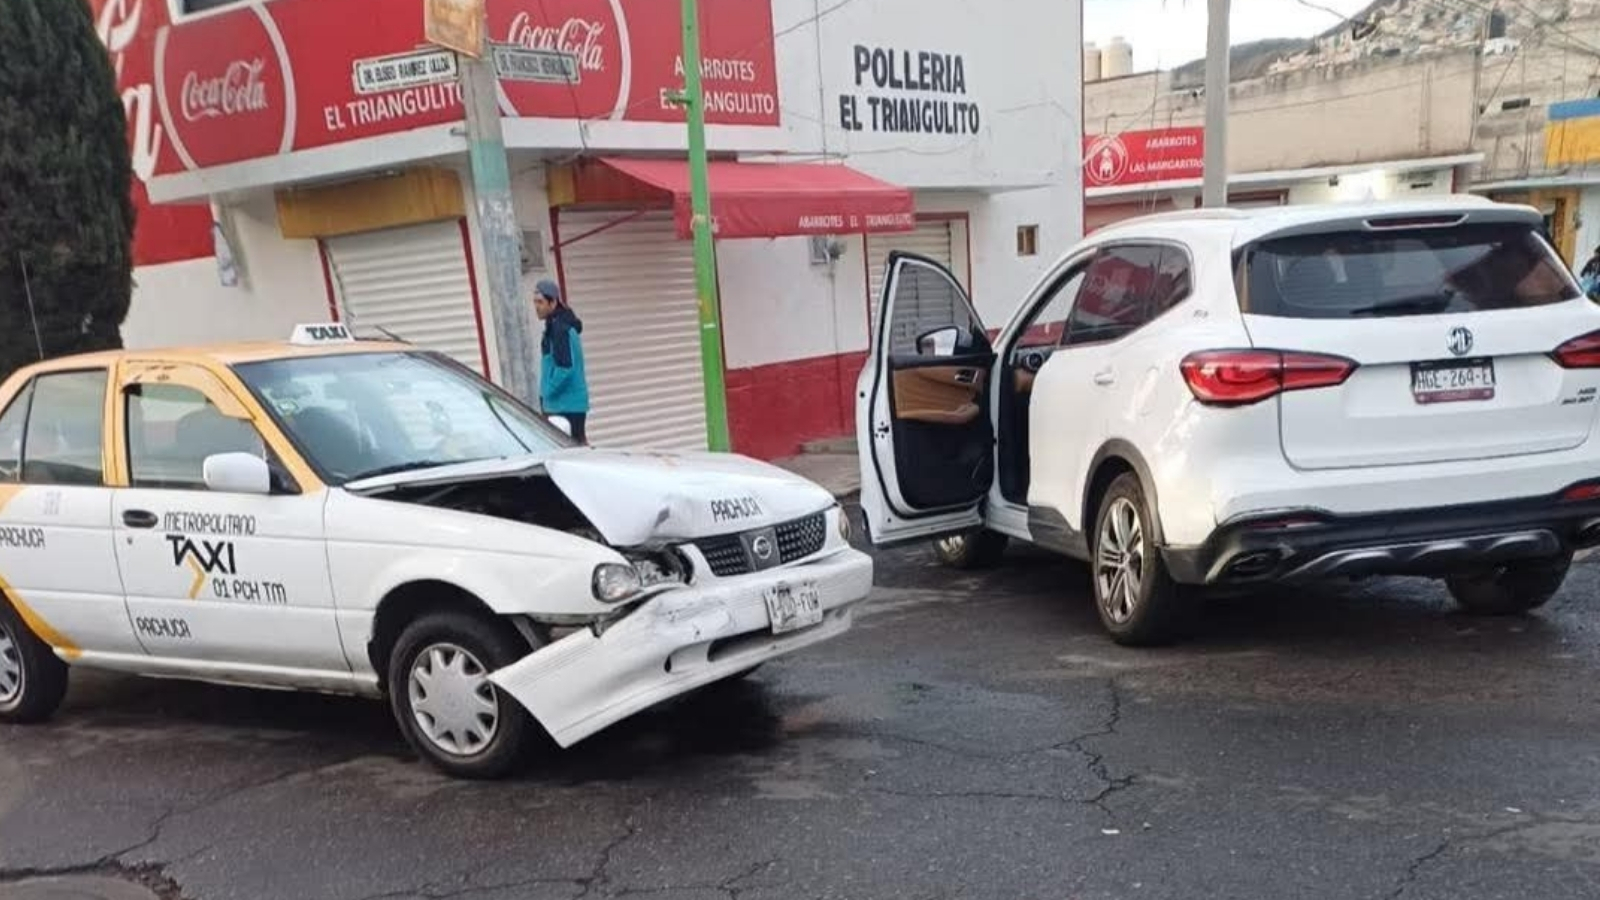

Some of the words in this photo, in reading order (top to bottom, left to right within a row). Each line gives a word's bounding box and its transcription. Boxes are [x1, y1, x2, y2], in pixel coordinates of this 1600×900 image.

[854, 45, 965, 94] POLLERIA
[324, 106, 345, 130] EL
[839, 94, 863, 130] EL
[868, 98, 980, 134] TRIANGULITO
[1129, 162, 1145, 173] LAS
[305, 326, 348, 340] TAXI
[711, 498, 762, 522] PACHUCA
[164, 511, 256, 536] METROPOLITANO
[166, 534, 236, 575] TAXI
[212, 578, 231, 598] 01
[233, 581, 260, 600] PCH
[264, 582, 287, 603] TM
[136, 616, 191, 638] PACHUCA
